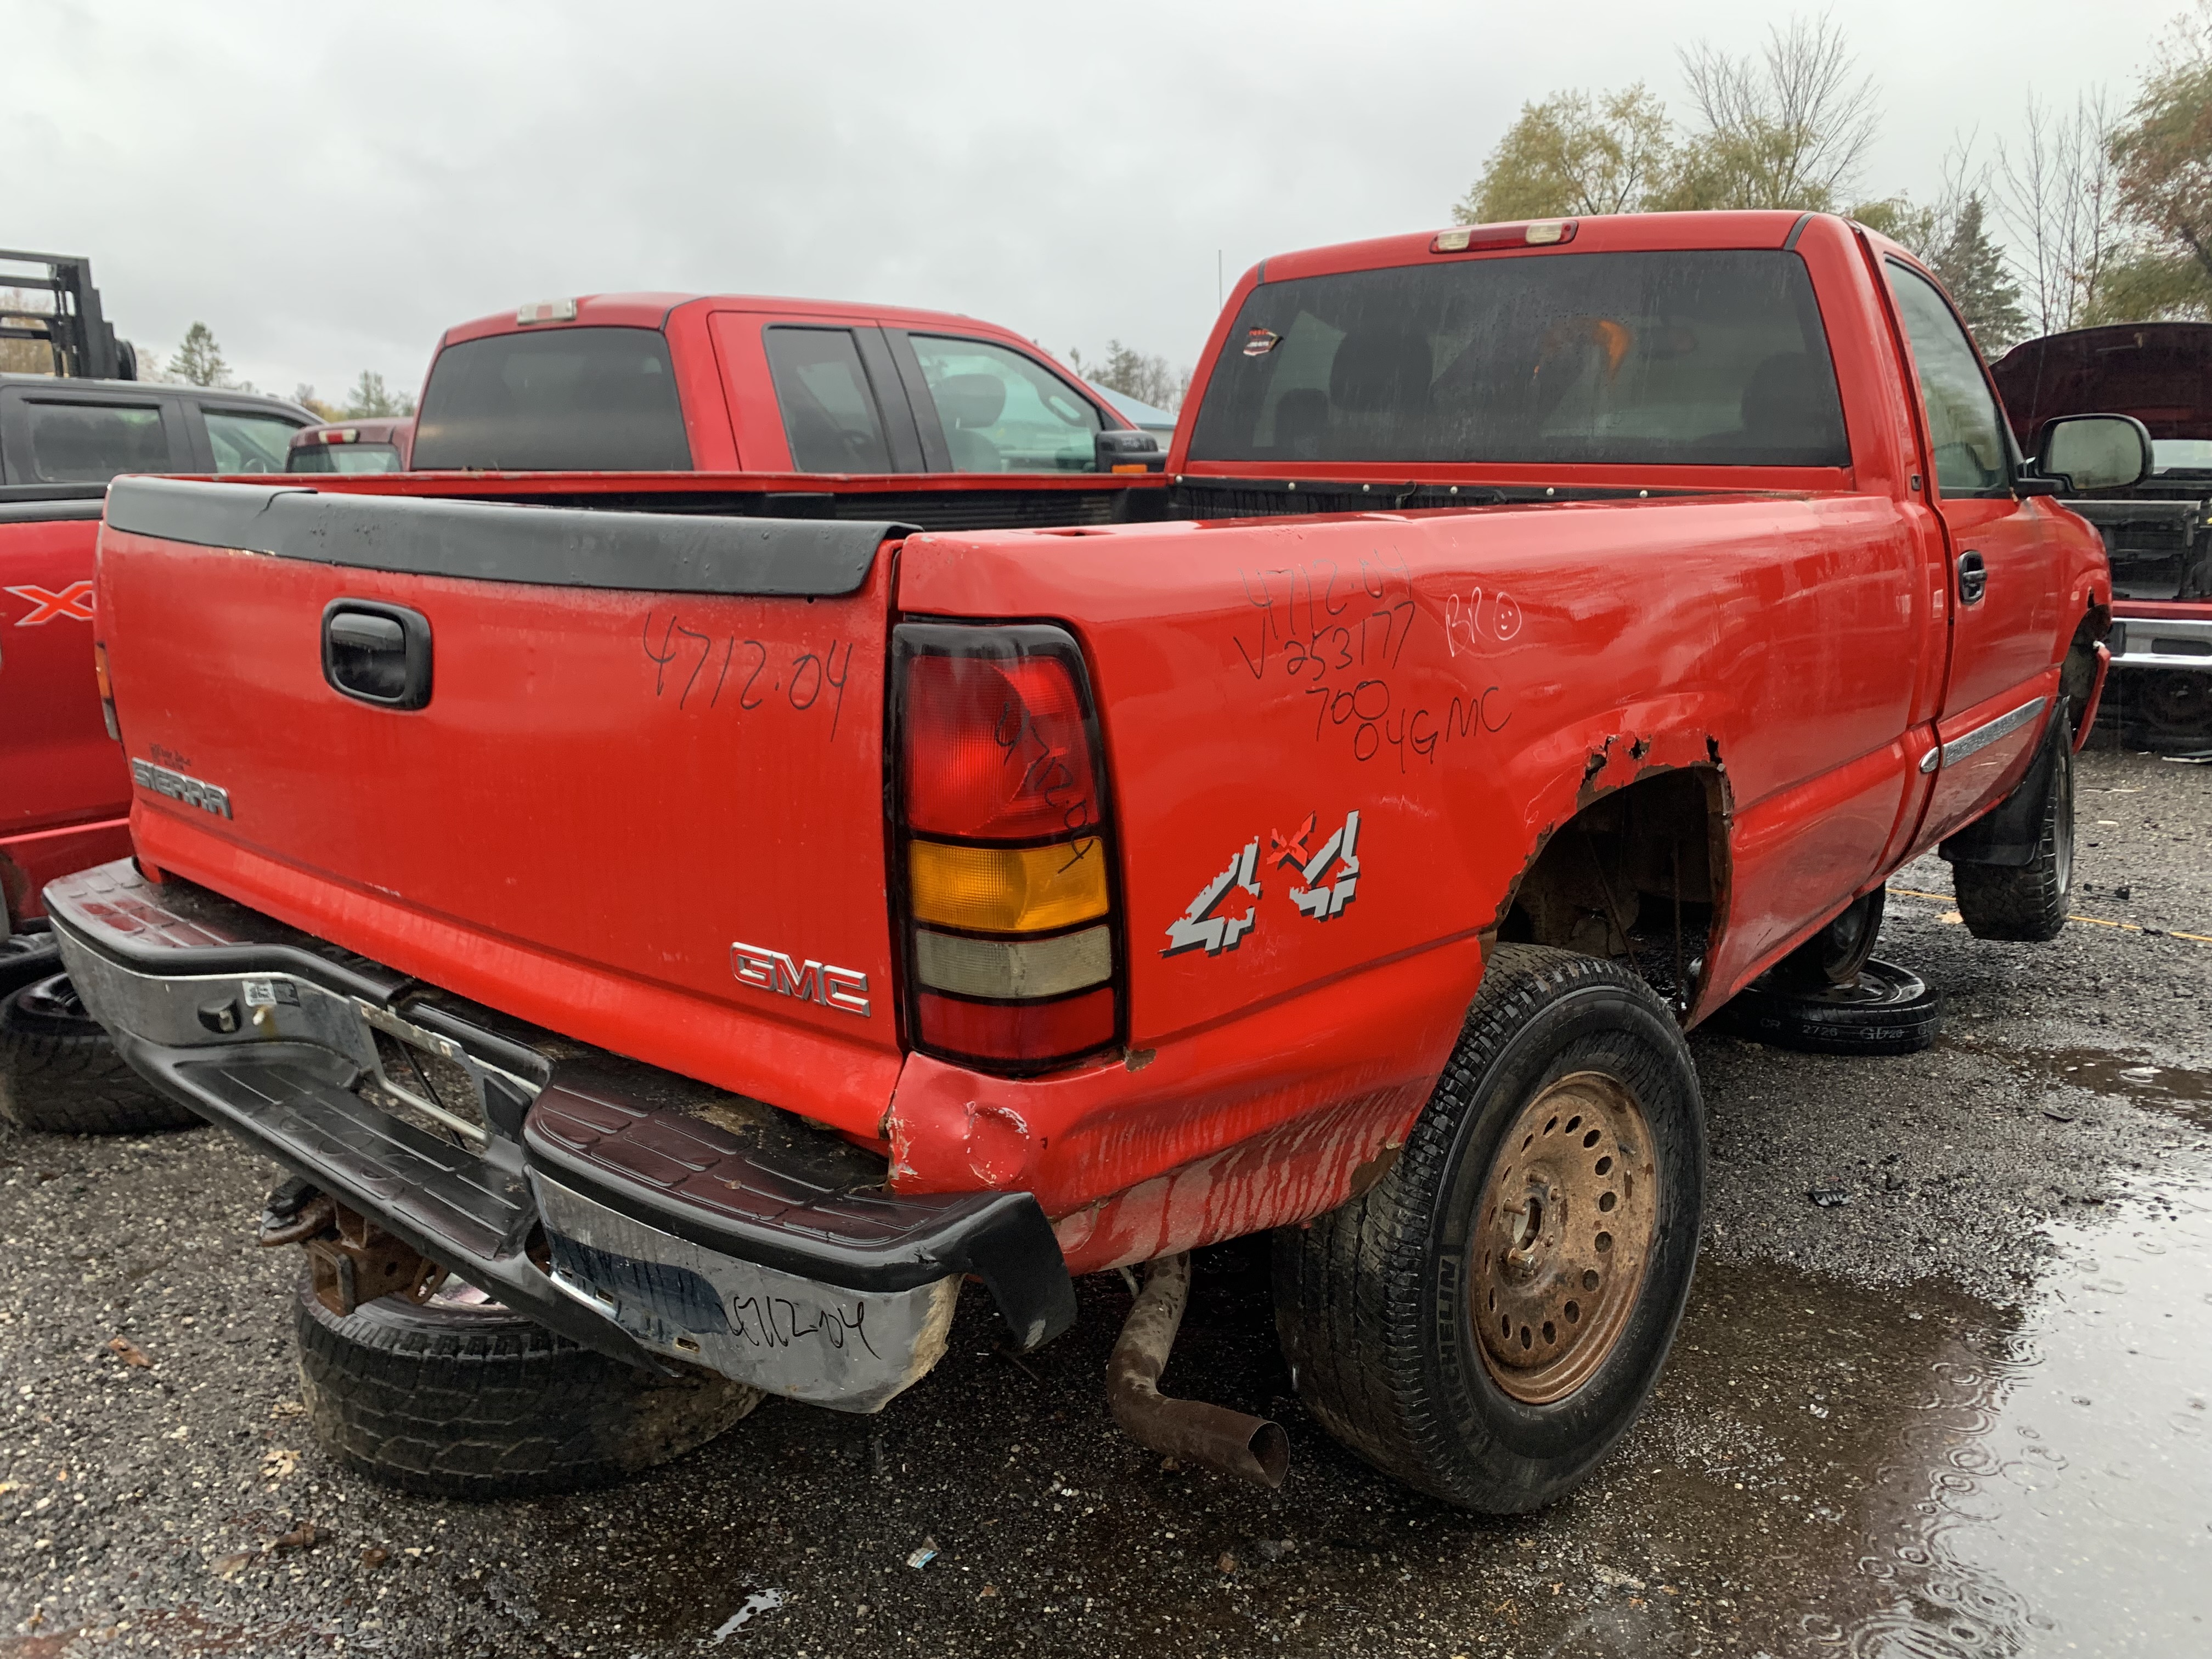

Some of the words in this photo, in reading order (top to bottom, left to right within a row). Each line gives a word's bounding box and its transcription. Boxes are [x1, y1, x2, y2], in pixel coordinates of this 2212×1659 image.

[642, 611, 853, 743] 4712.04
[132, 756, 234, 821] SIERRA
[731, 941, 871, 1017] GMC
